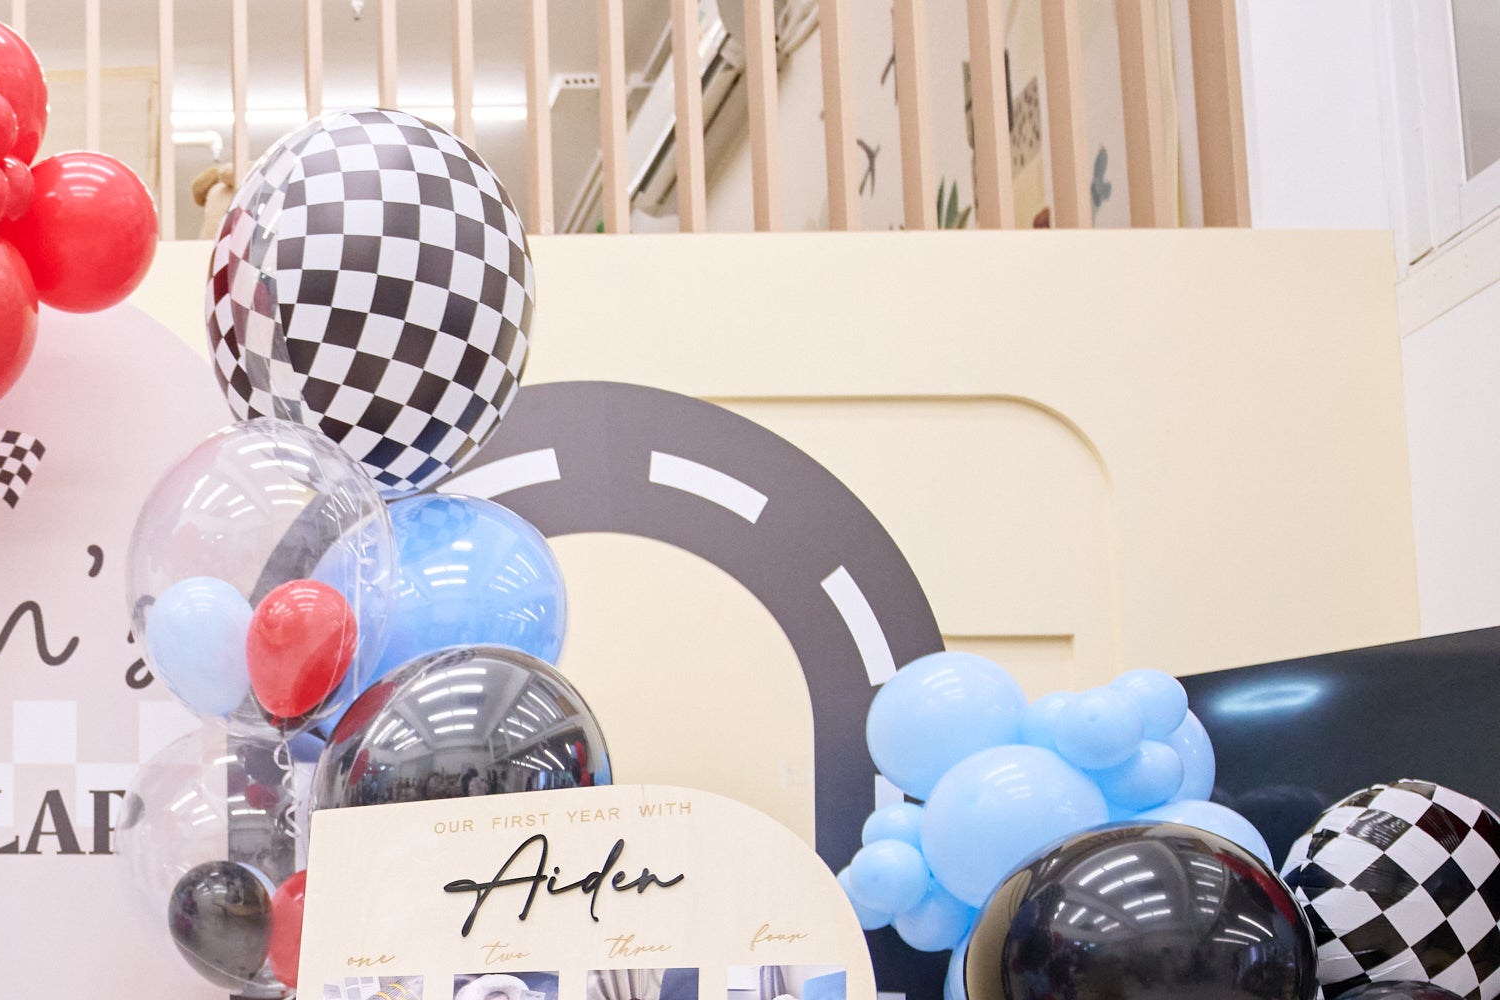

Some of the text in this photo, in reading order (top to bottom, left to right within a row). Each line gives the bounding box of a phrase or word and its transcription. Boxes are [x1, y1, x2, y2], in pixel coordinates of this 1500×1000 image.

[433, 801, 693, 835] OUR FIRST YEAR WITH
[443, 833, 685, 938] Aiden
[346, 923, 809, 968] one two three four
